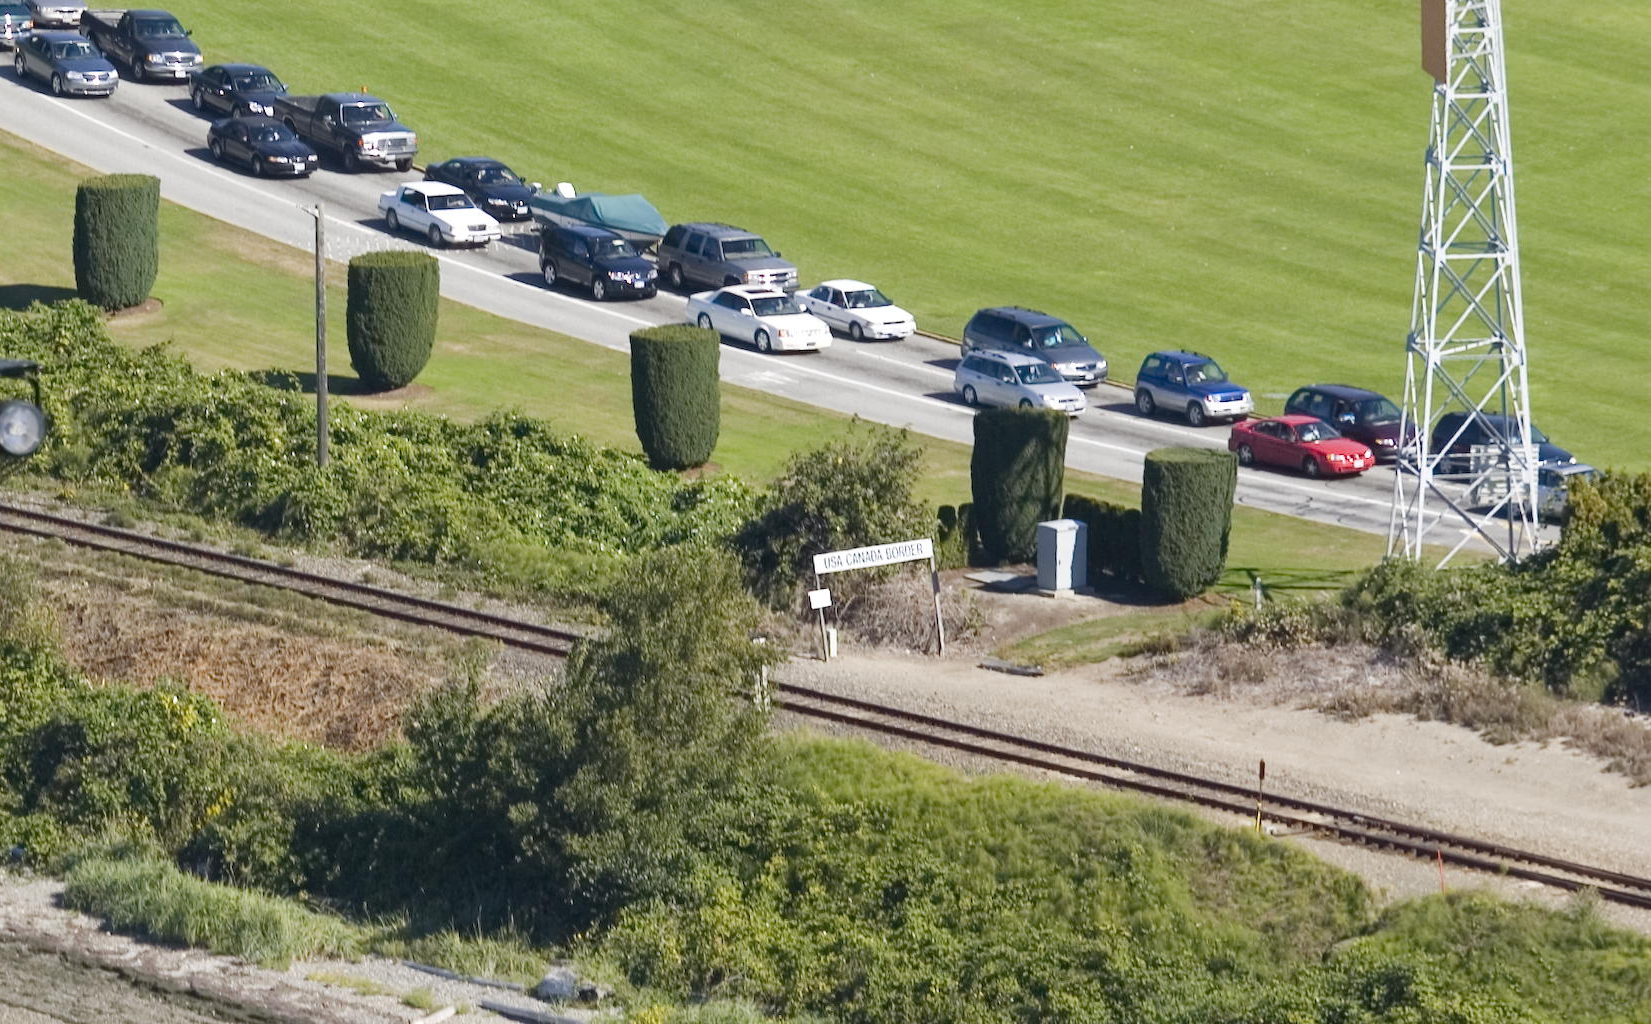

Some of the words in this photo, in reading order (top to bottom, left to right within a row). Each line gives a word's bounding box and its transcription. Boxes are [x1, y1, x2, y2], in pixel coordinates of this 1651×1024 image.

[823, 556, 843, 570] USA
[845, 549, 883, 565] CANADA
[885, 542, 924, 559] BORDER
